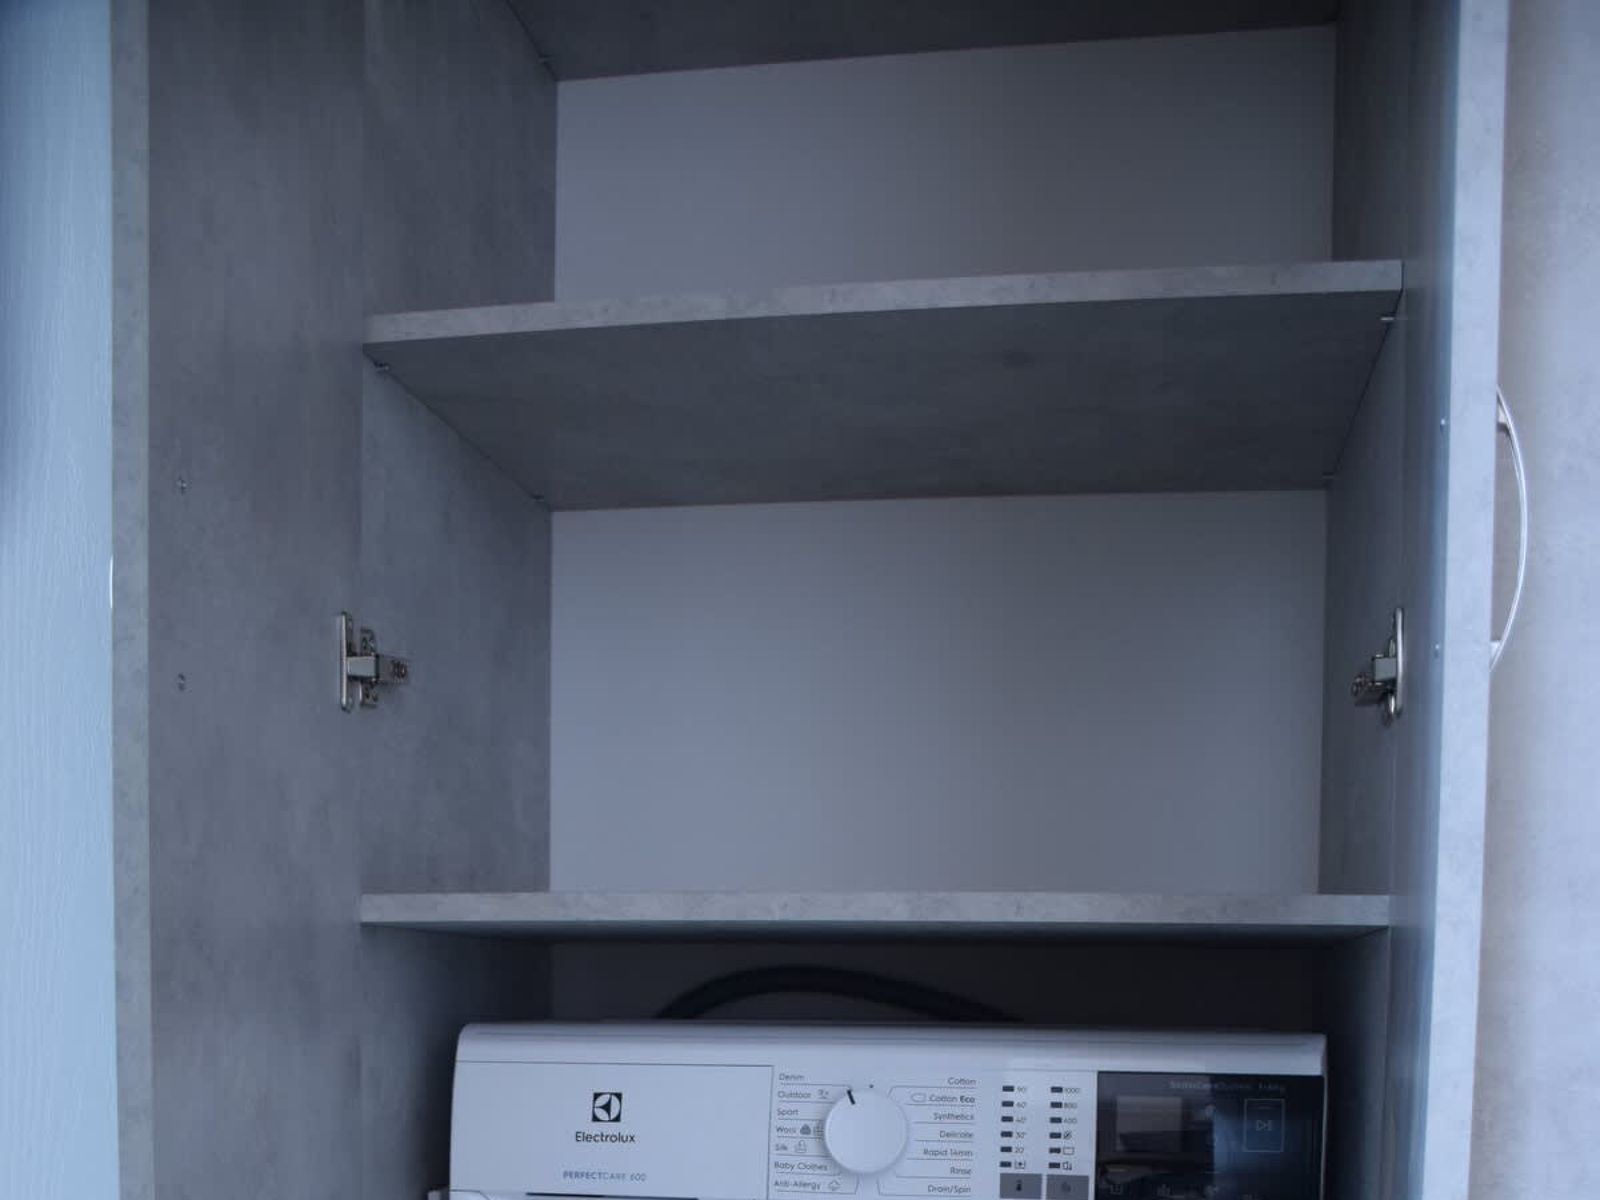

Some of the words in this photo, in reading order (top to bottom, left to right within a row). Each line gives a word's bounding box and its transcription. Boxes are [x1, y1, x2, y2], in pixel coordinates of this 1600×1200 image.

[959, 1096, 976, 1104] Eco
[575, 1131, 636, 1143] Electrolux
[774, 1161, 795, 1171] Baby
[563, 1170, 626, 1181] PERFECTCARE
